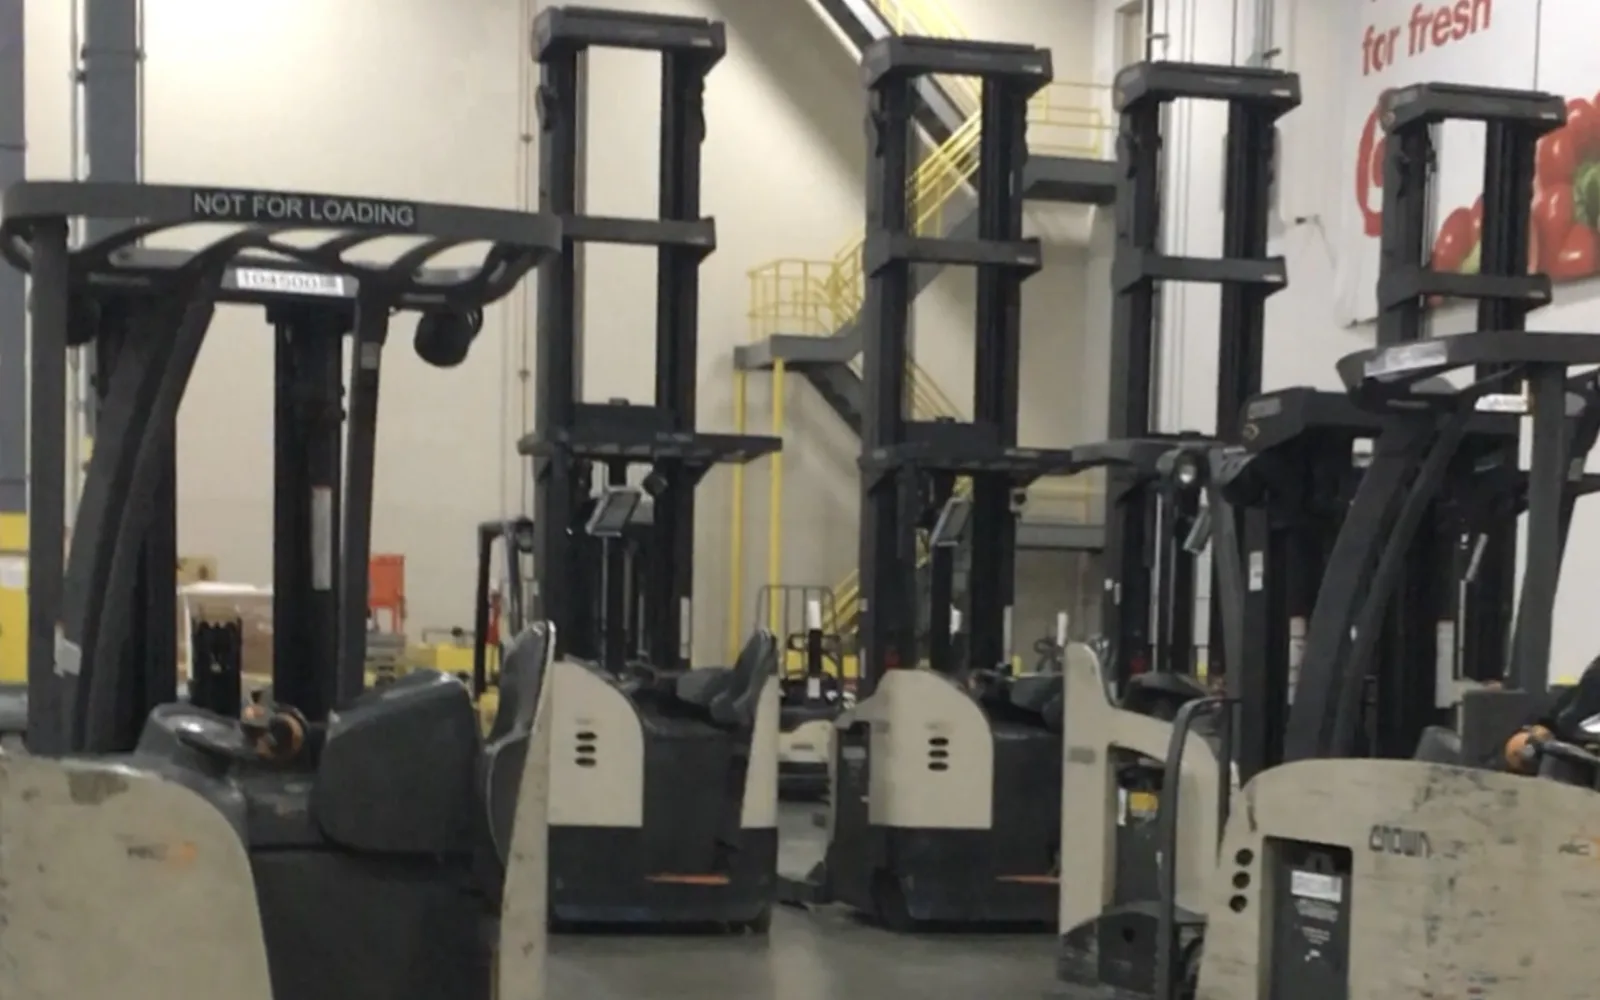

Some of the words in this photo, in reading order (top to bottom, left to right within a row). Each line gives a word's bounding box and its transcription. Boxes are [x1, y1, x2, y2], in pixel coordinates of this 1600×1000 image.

[1362, 24, 1400, 76] for
[193, 192, 246, 216] NOT
[253, 195, 303, 218] FOR
[310, 198, 414, 226] LOADING
